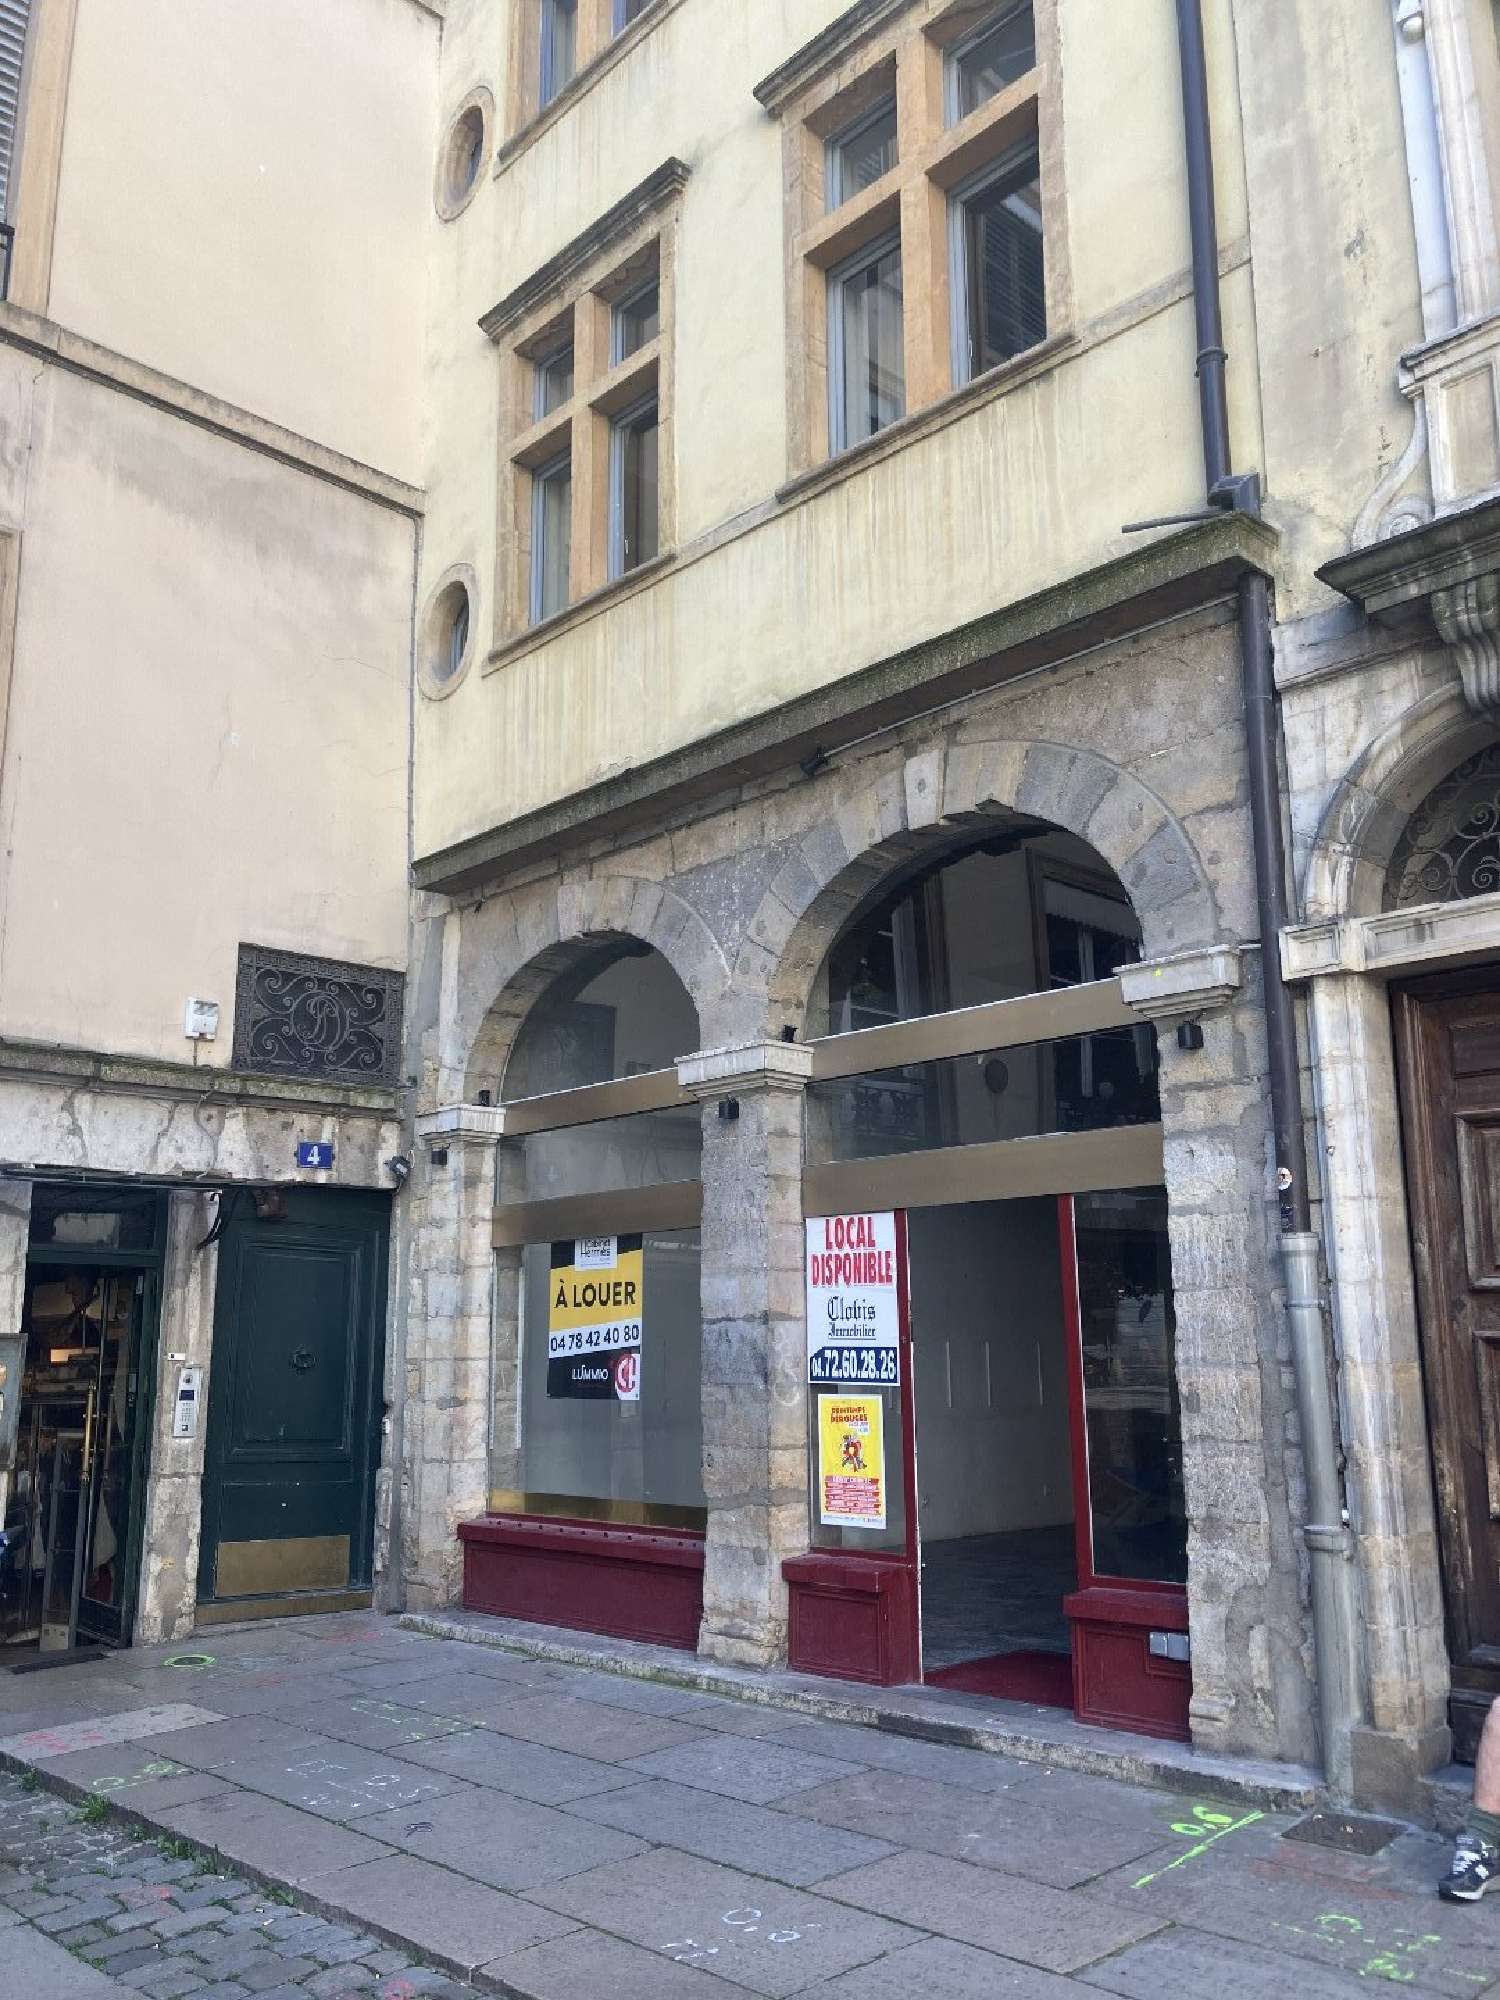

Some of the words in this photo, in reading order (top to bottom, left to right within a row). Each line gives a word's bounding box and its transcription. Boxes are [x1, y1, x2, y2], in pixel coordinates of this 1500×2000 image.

[306, 1146, 320, 1164] 4
[825, 1216, 876, 1250] LOCAL
[811, 1251, 893, 1287] DISPONIBLE
[554, 1279, 568, 1308] À
[573, 1281, 636, 1308] LOUER
[550, 1335, 566, 1352] 04
[568, 1332, 583, 1350] 78
[585, 1330, 601, 1347] 42
[603, 1328, 620, 1344] 40
[624, 1324, 640, 1343] 80
